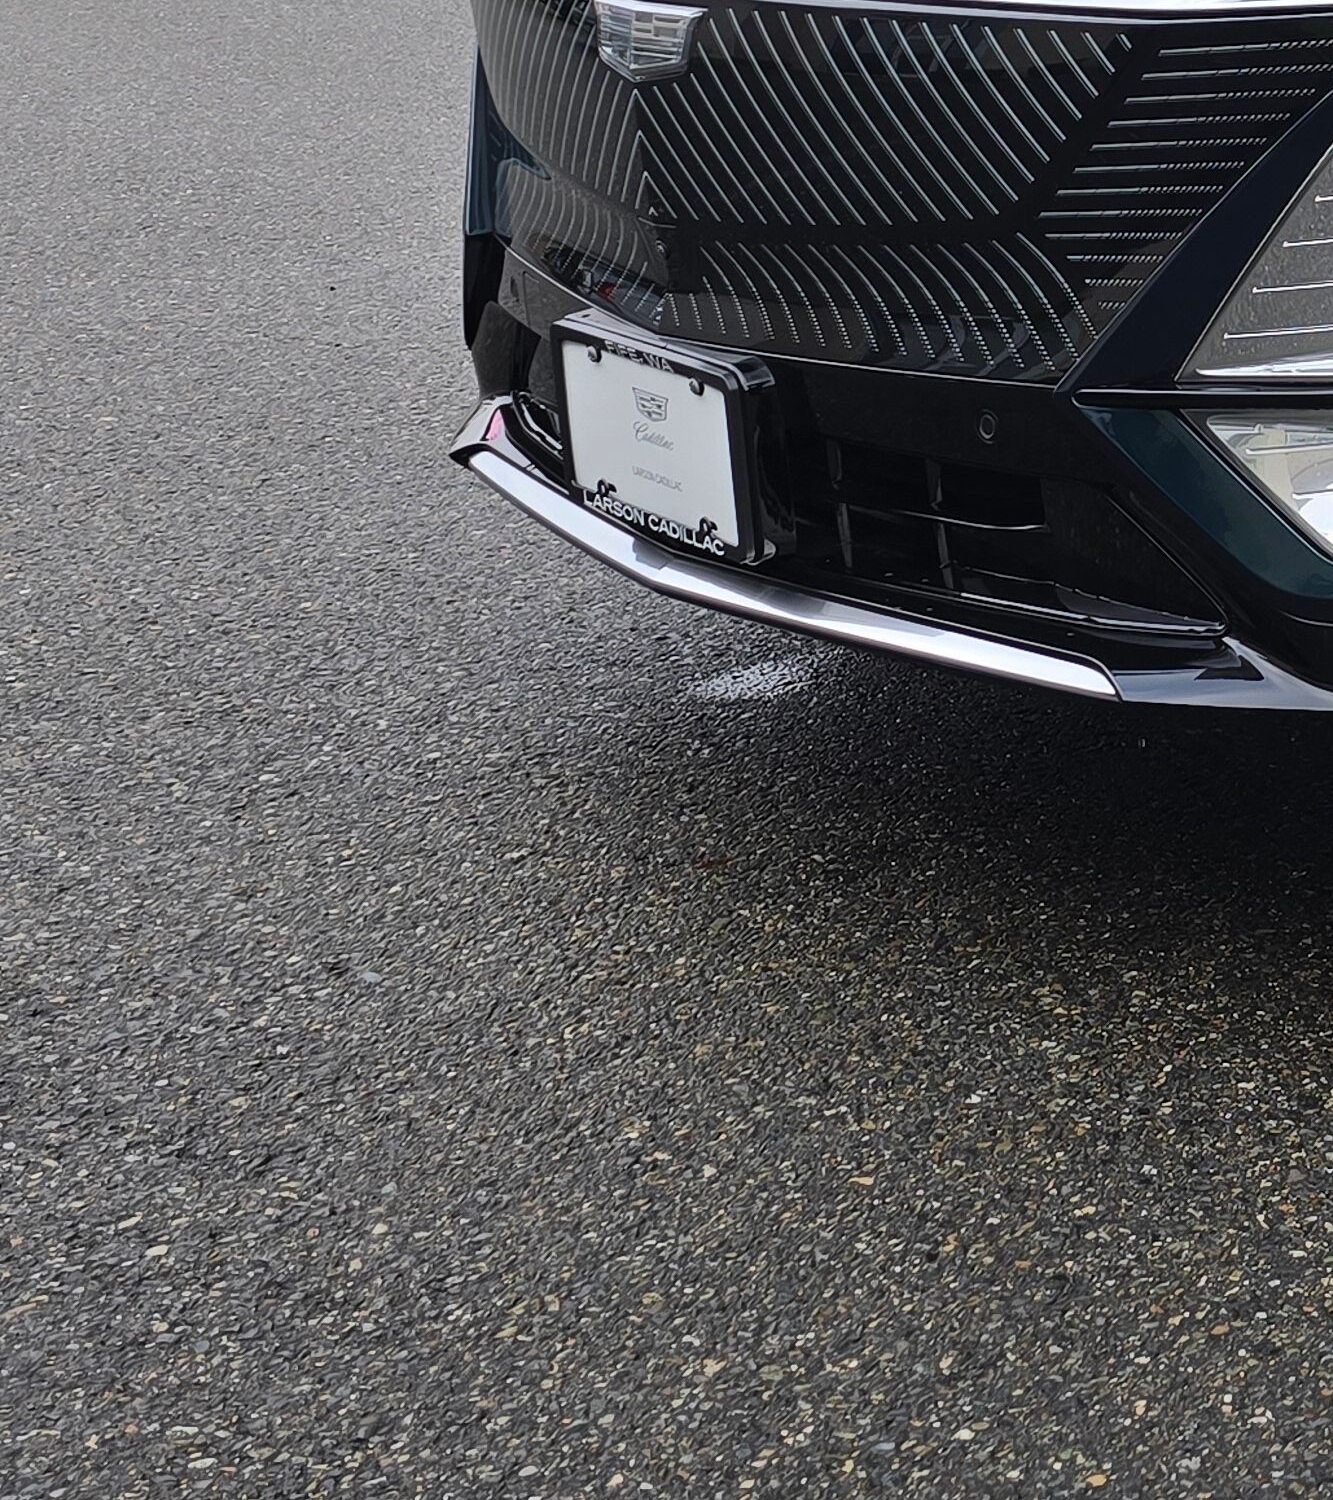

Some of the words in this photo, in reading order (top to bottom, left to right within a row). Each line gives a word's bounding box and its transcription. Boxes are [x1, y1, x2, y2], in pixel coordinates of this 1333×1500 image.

[648, 354, 675, 374] WA
[583, 489, 645, 527] LARSON
[648, 512, 725, 556] CADILLAC
